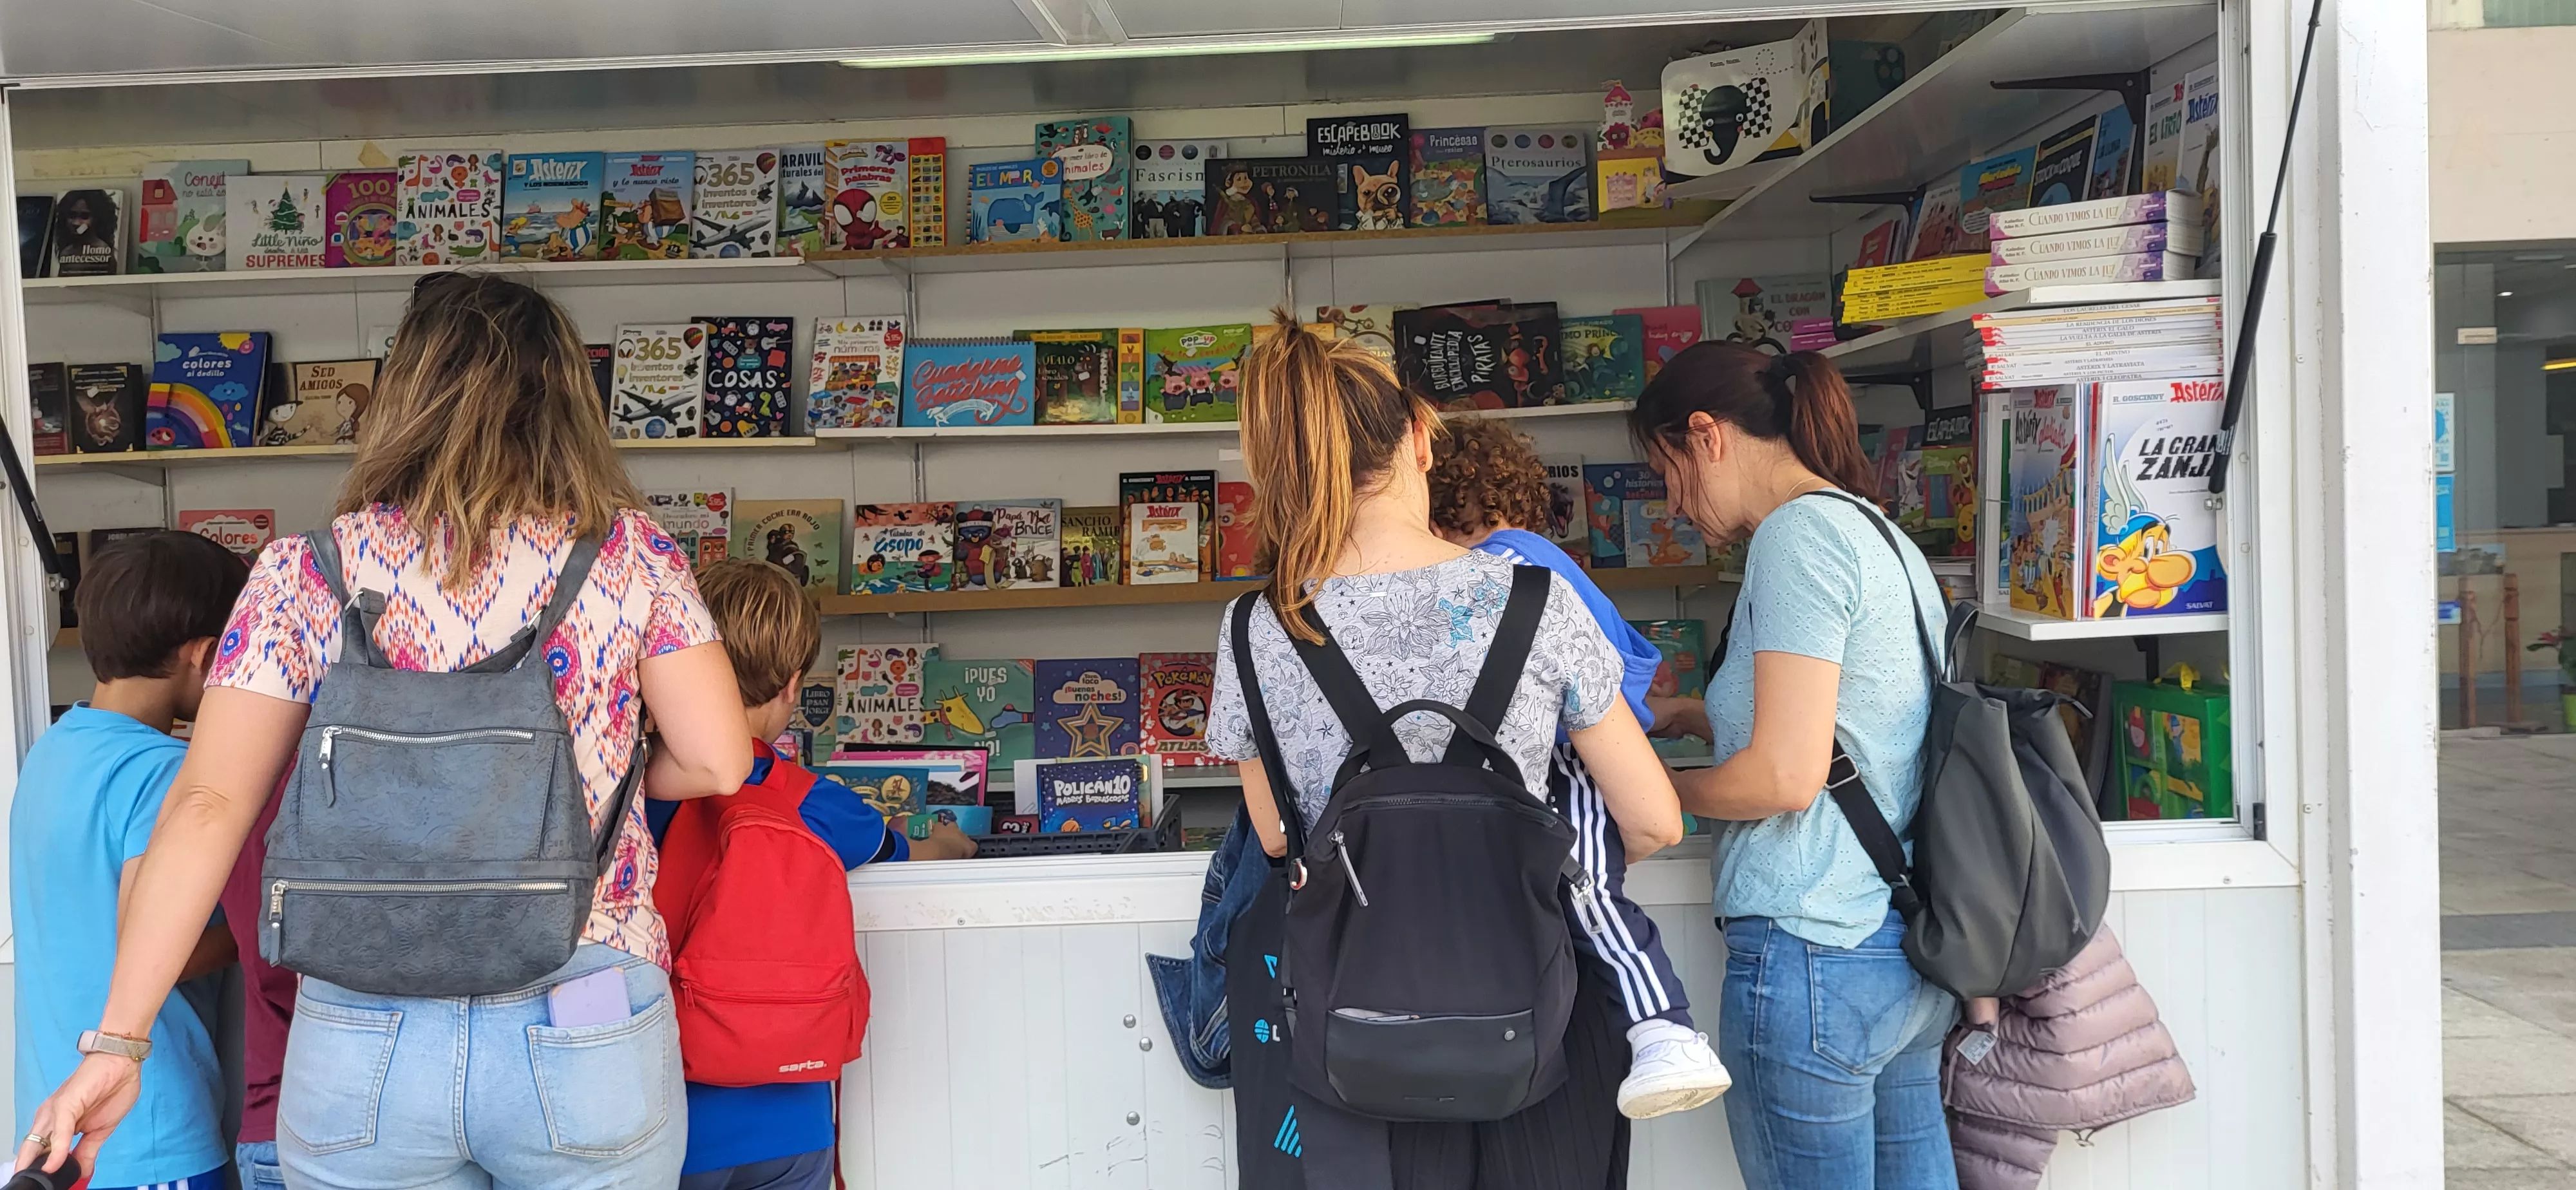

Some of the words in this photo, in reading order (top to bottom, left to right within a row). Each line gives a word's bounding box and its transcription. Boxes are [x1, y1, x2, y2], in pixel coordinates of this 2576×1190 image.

[781, 152, 825, 168] ARAVIL
[1065, 160, 1104, 174] nimales
[1491, 155, 1582, 169] Pterosaurios
[708, 162, 755, 187] 365
[781, 167, 813, 178] turales
[1135, 167, 1206, 183] Fascism
[1253, 164, 1332, 178] PETRONILA
[185, 171, 226, 189] Conejit
[976, 173, 994, 187] EL
[405, 202, 491, 220] ANIMALES
[2029, 212, 2063, 226] CUANDO
[2066, 209, 2090, 222] VIMOS
[2093, 208, 2103, 219] LA
[2106, 206, 2119, 220] LUZ
[285, 235, 323, 247] Niño
[2030, 240, 2065, 254] CUANDO
[2067, 239, 2092, 250] VIMOS
[2094, 237, 2105, 247] LA
[2107, 236, 2120, 249] LUZ
[82, 245, 111, 255] Homo
[59, 253, 111, 264] antecessor
[246, 254, 325, 268] SUPREMES
[2024, 267, 2060, 281] CUANDO
[2062, 267, 2087, 278] VIMOS
[2089, 265, 2100, 276] LA
[2102, 264, 2116, 278] LUZ
[634, 336, 683, 361] 365
[182, 357, 232, 370] colores
[1467, 334, 1497, 384] PIRATAS
[197, 369, 225, 377] dedillo
[310, 365, 336, 379] SED
[708, 369, 778, 389] COSAS
[299, 379, 343, 392] AMIGOS
[2122, 393, 2164, 402] GOSCINNY
[2138, 437, 2166, 457] LA
[2136, 453, 2215, 481] ZANJ
[761, 509, 786, 525] COCHE
[786, 508, 801, 518] ERA
[801, 511, 821, 531] ROJO
[992, 507, 1024, 524] Papá
[663, 516, 710, 531] mundo
[2185, 600, 2214, 610] SALVAT
[976, 686, 996, 702] YO
[1075, 690, 1122, 702] noches!
[1157, 741, 1210, 753] ATLAS
